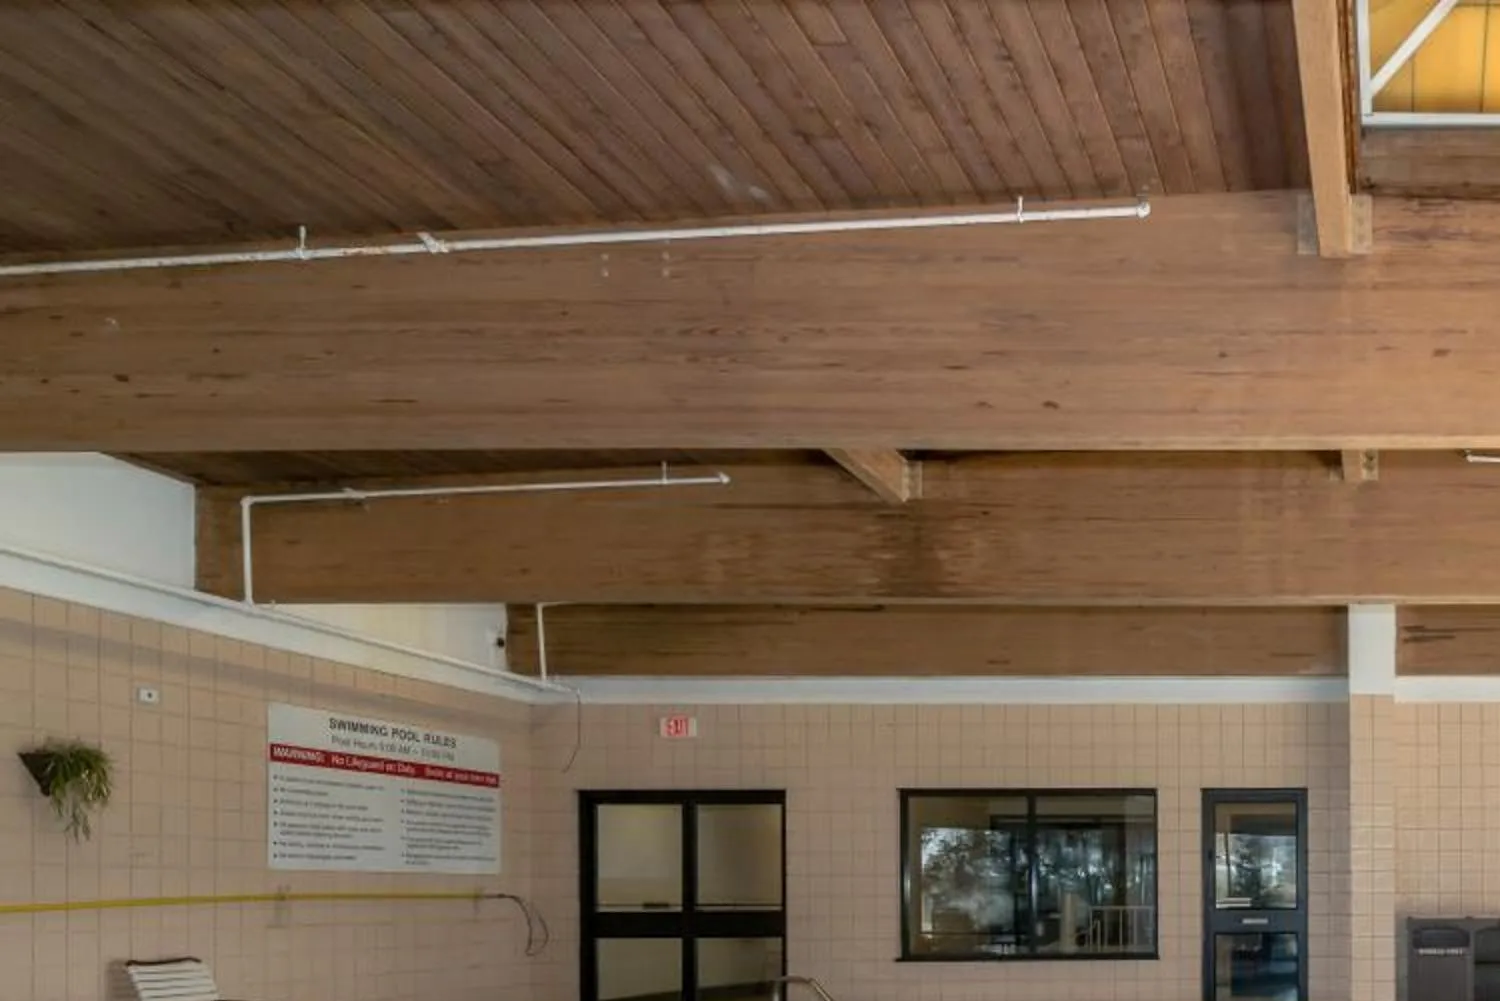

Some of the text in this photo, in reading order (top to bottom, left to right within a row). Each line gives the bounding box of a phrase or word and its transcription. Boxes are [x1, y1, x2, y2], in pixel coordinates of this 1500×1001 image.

[329, 718, 456, 748] SWIMMING POOL RULES
[331, 755, 344, 765] No
